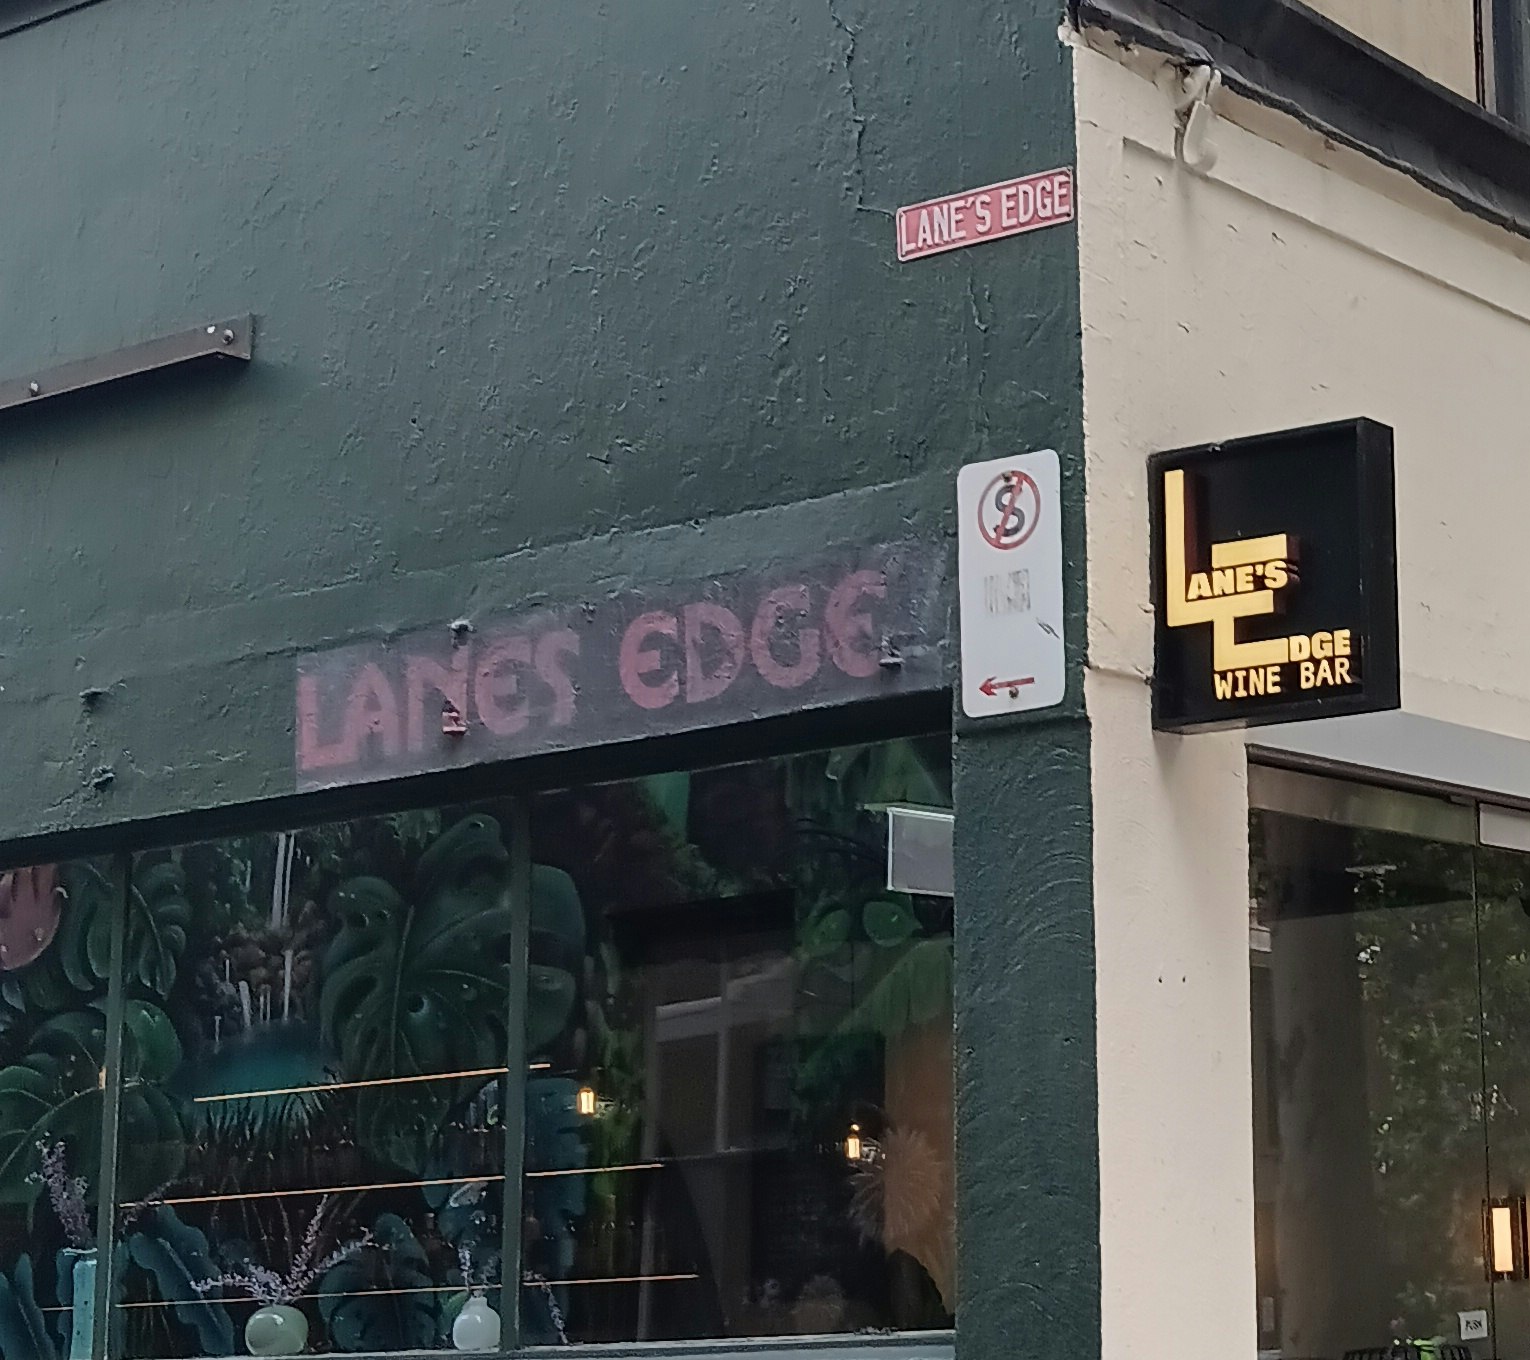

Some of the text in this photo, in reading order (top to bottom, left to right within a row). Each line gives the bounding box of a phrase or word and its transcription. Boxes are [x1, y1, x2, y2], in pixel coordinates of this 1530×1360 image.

[901, 174, 1070, 255] LANE'S EDGE
[620, 569, 888, 710] EDGE
[1214, 657, 1351, 700] WINE BAR
